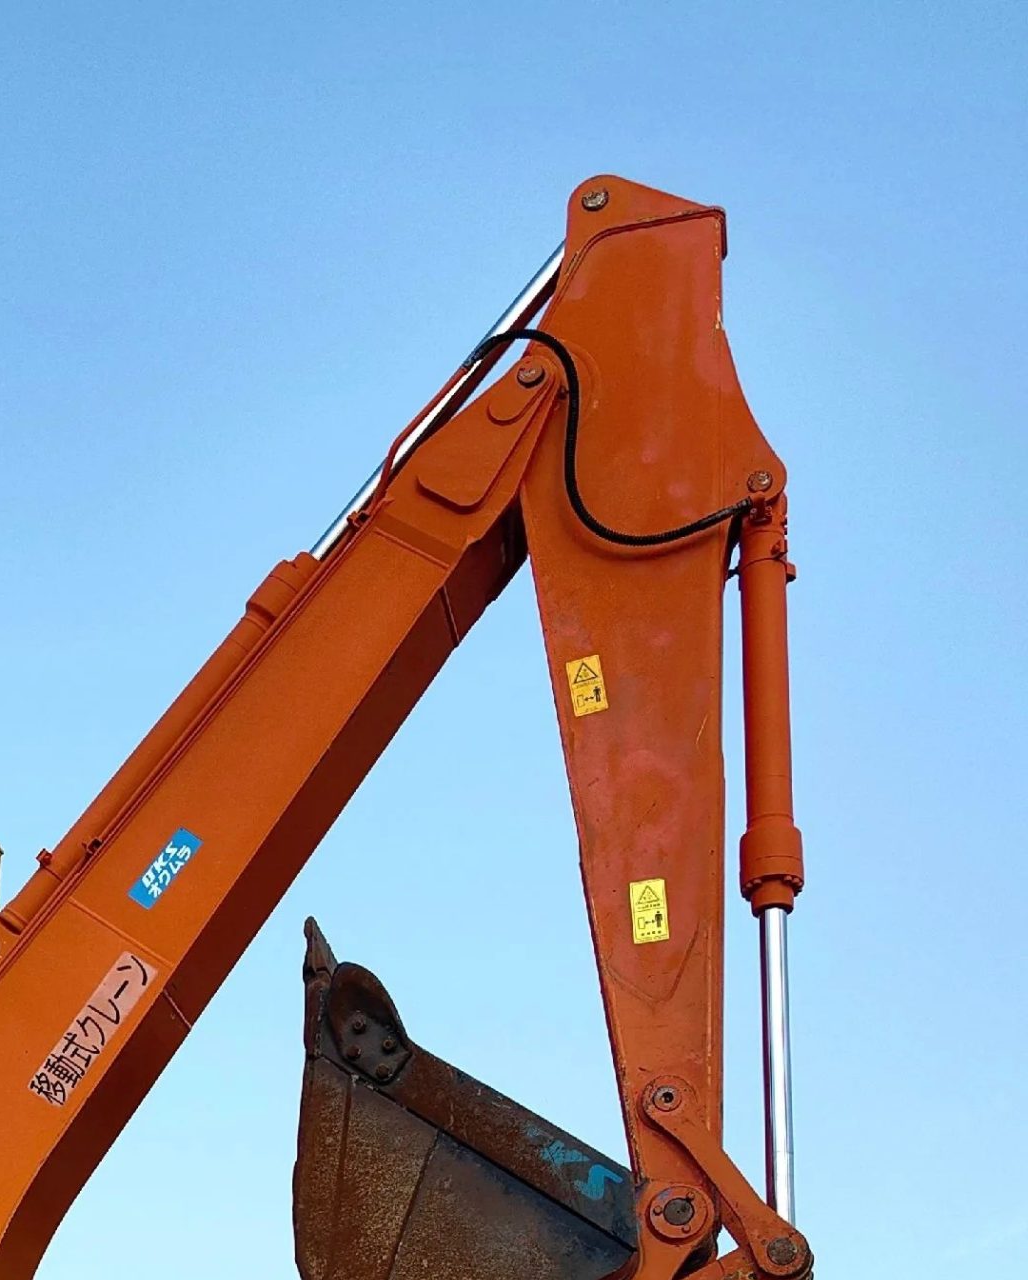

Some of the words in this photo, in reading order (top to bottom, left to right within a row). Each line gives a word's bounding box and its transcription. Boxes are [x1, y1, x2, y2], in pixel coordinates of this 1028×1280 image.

[147, 844, 193, 900] オクムラ
[29, 954, 149, 1107] 移動式クレーン
